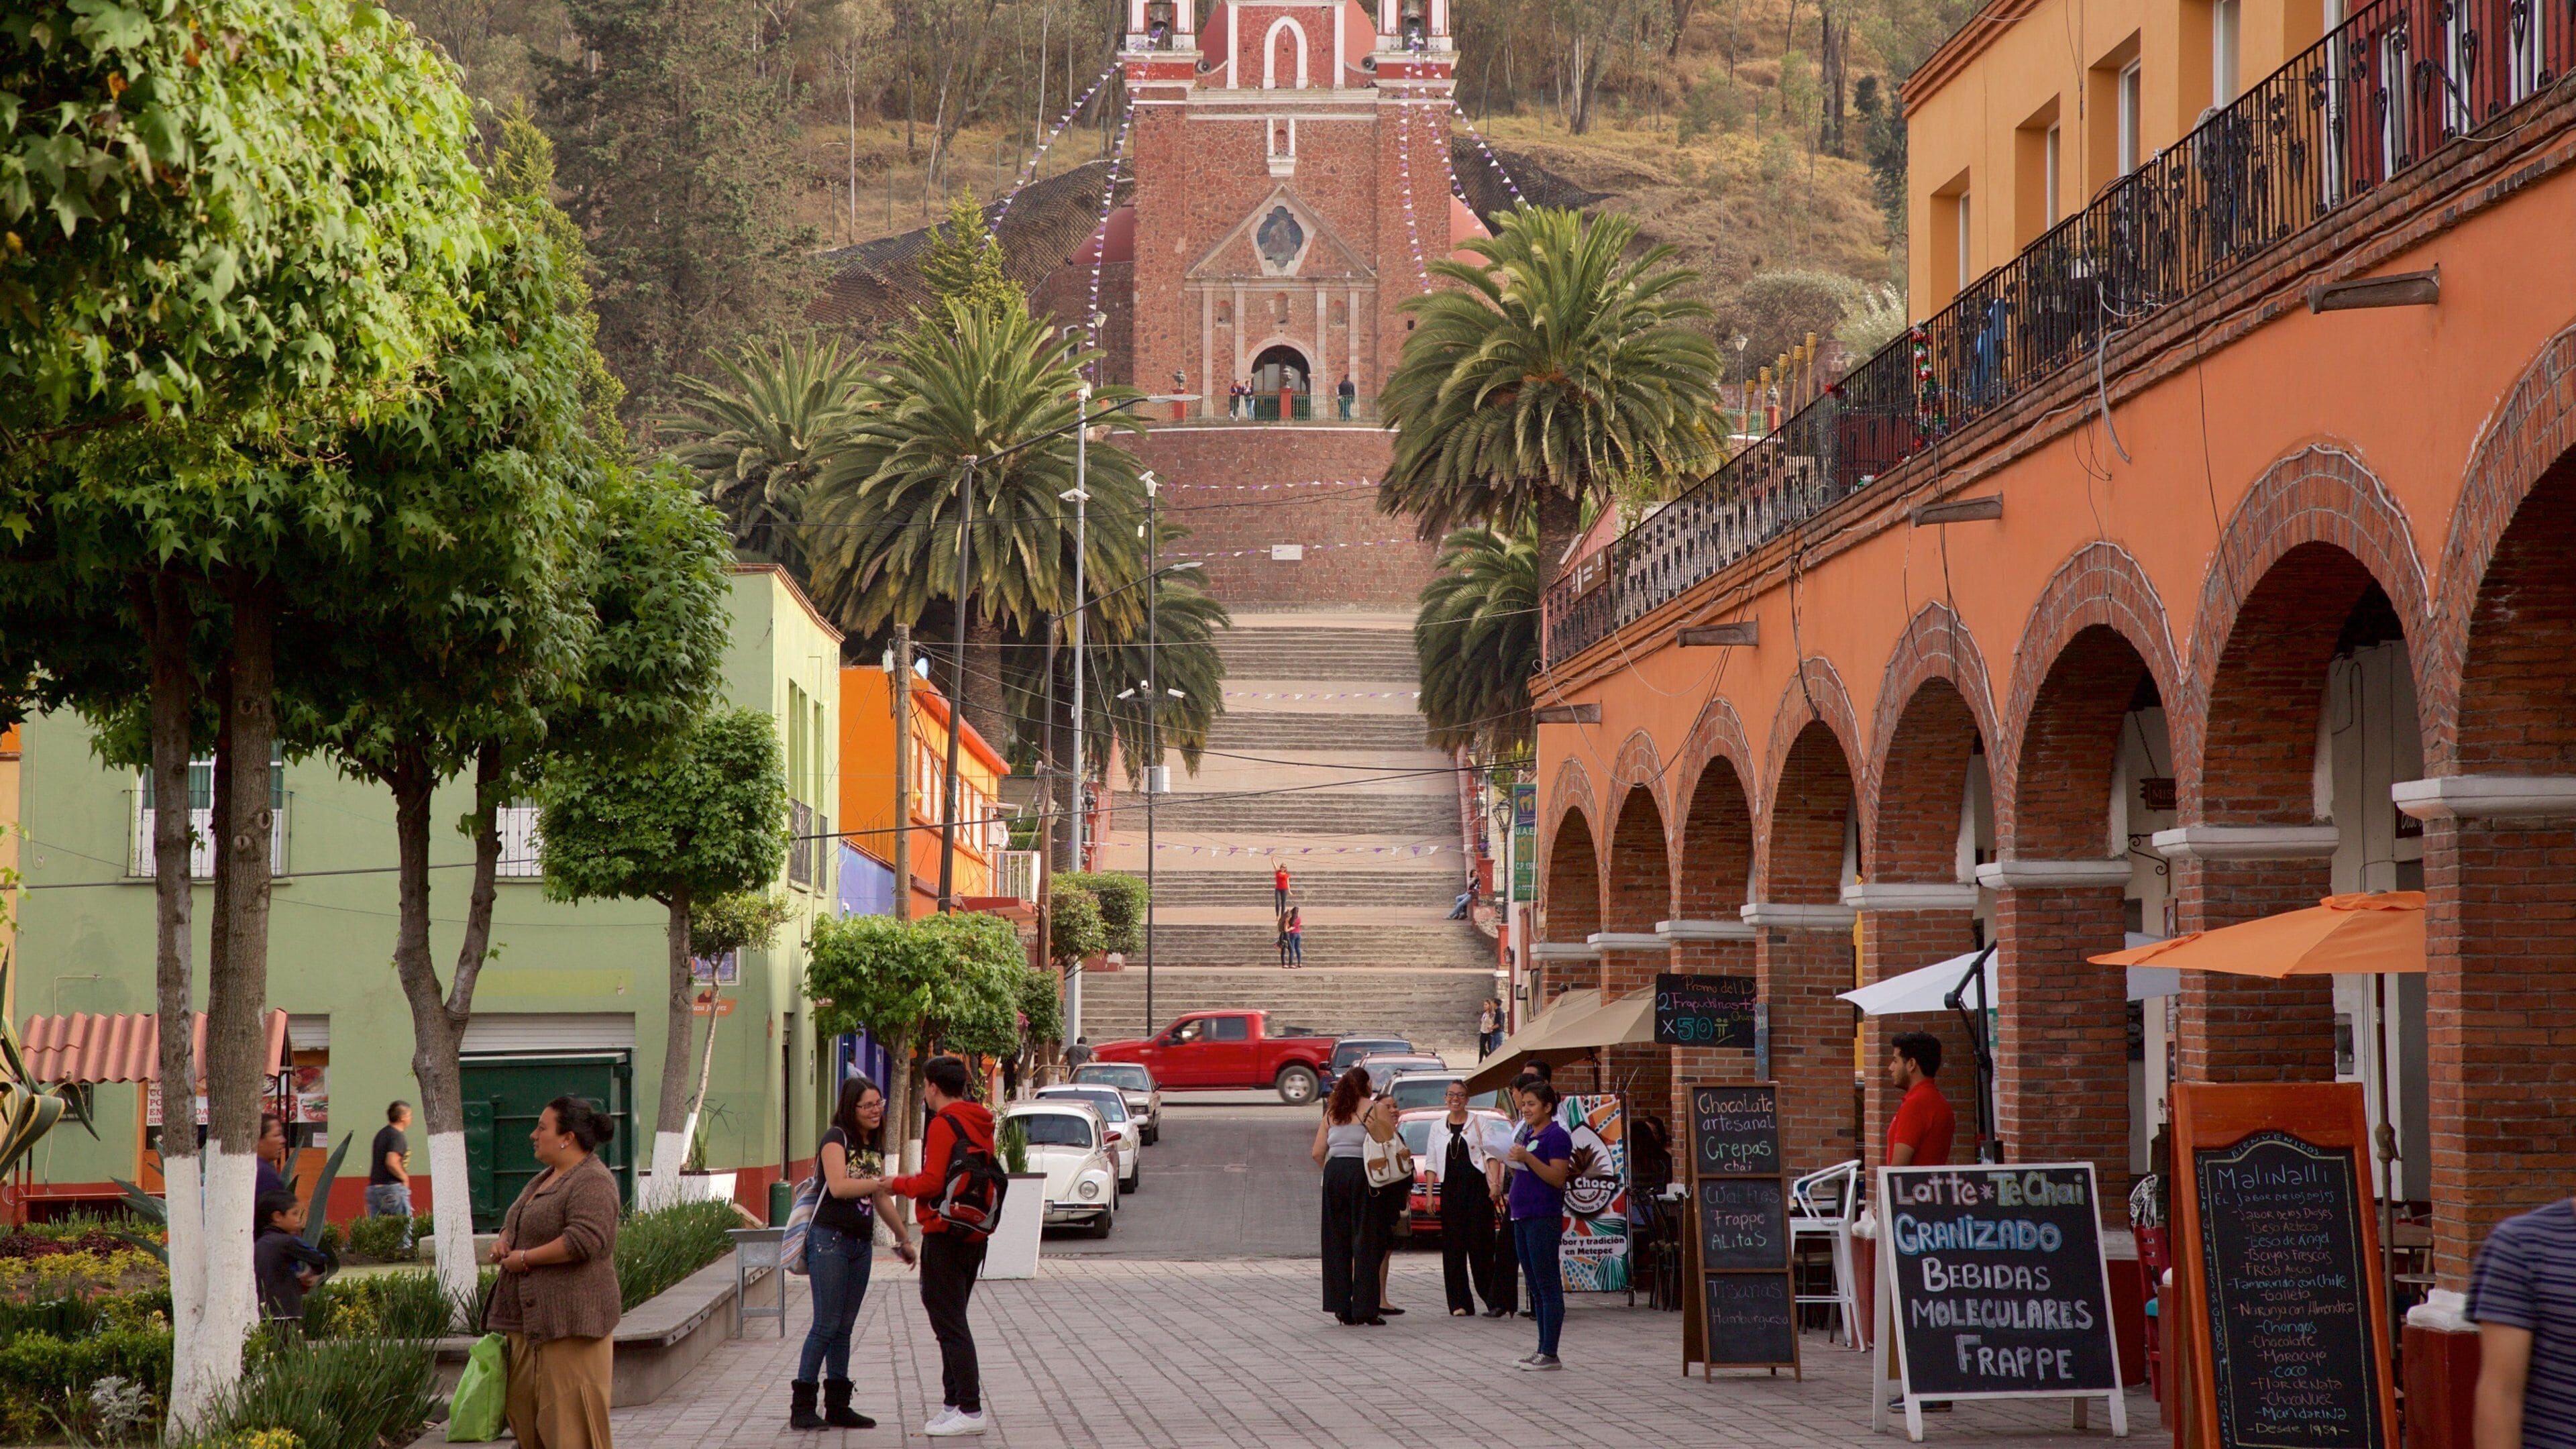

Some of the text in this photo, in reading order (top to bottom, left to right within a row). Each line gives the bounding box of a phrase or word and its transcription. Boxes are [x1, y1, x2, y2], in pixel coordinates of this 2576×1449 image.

[1682, 975, 1717, 994] Promo
[1720, 980, 1737, 995] del
[1657, 992, 1671, 1011] 2
[1677, 1016, 1713, 1040] 50
[1706, 1136, 1771, 1163] Crepas
[2231, 1133, 2319, 1159] BIENVENIDOS
[1724, 1160, 1752, 1171] chai
[1574, 1177, 1616, 1190] Choco
[1894, 1172, 1978, 1206] Latte
[1599, 1191, 1609, 1203] Bar
[1711, 1210, 1765, 1231] Frappe
[2283, 1220, 2318, 1233] Azteca
[1586, 1236, 1625, 1245] tradición
[1578, 1248, 1613, 1256] Metepec
[2248, 1248, 2333, 1265] Bayas Frescas
[1922, 1257, 2051, 1292] BEBIDAS
[2317, 1274, 2348, 1289] Chile
[2265, 1288, 2310, 1301] Galleta
[1911, 1298, 2093, 1330] MOLECULARES
[2253, 1334, 2316, 1348] Chocolate
[1955, 1333, 2076, 1381] FRAPPE
[2293, 1379, 2308, 1389] de
[2310, 1377, 2343, 1391] Nata
